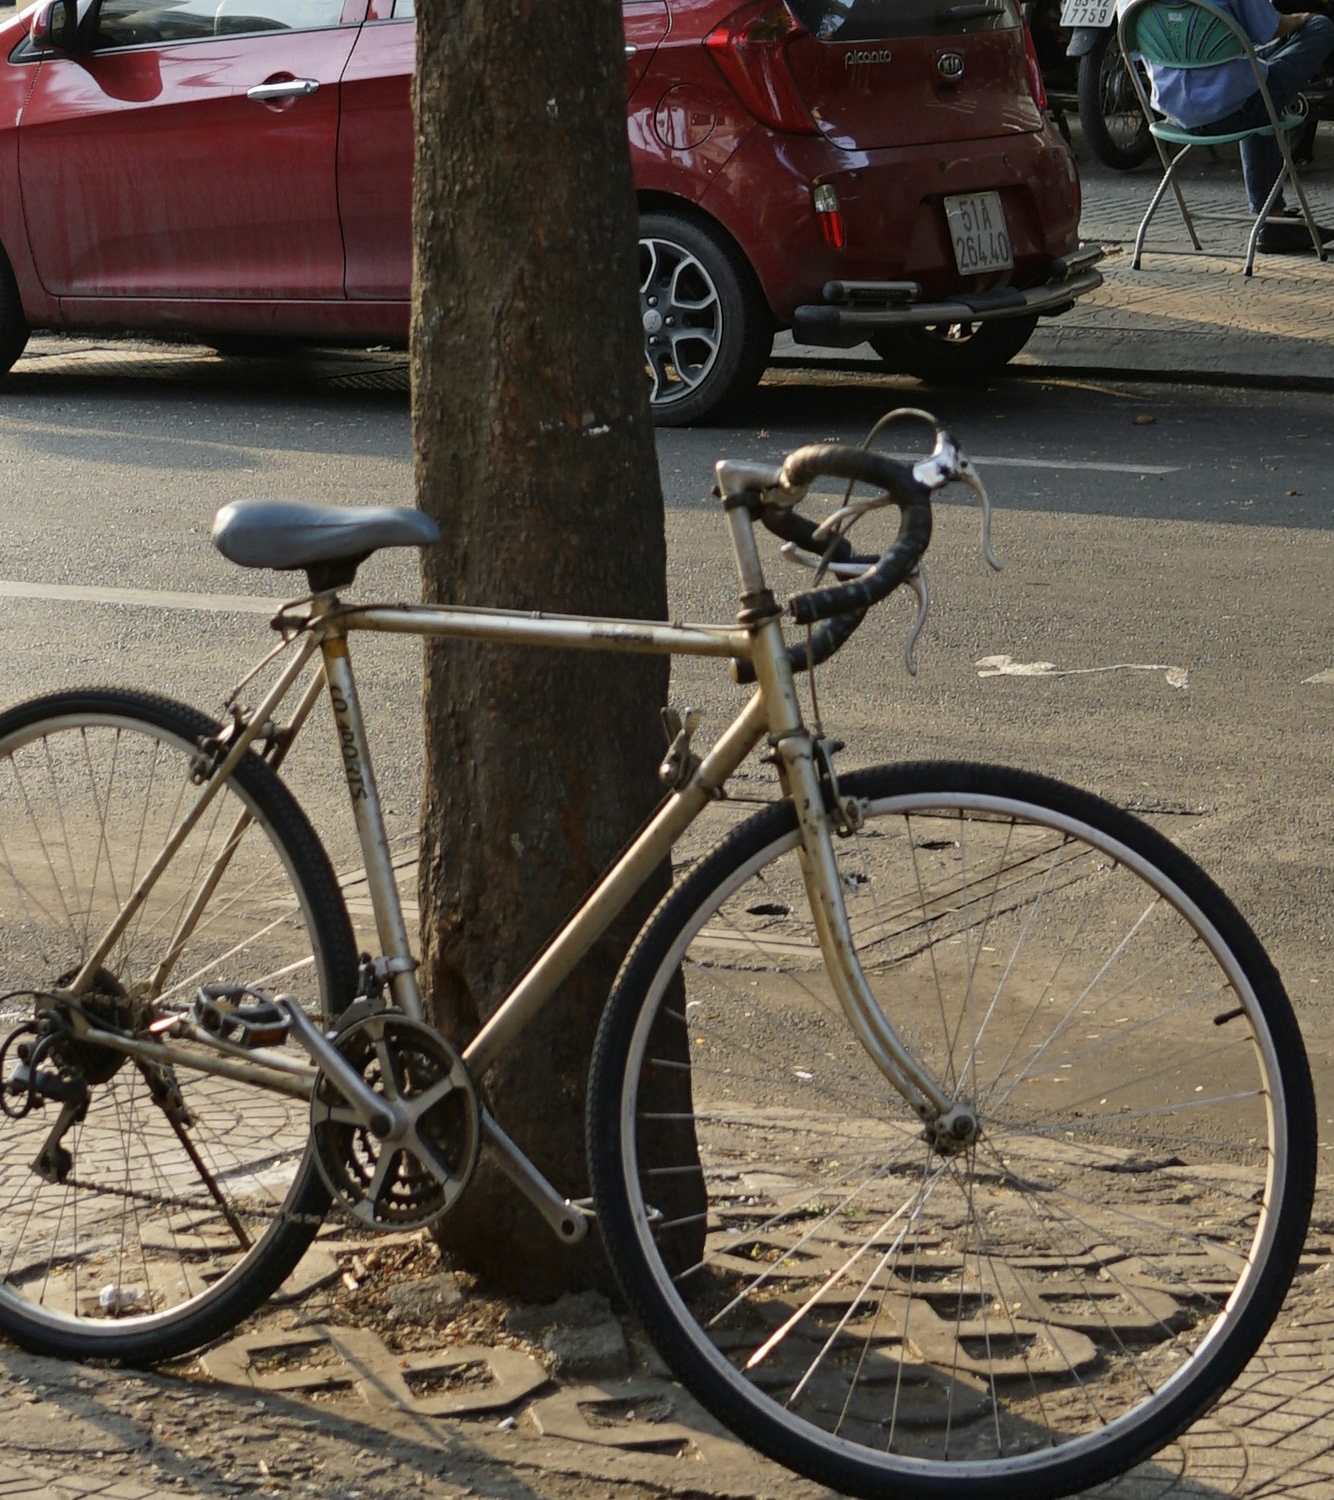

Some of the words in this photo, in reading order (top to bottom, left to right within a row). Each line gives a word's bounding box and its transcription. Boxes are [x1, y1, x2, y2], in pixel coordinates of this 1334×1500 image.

[1070, 9, 1107, 23] 7759
[844, 49, 892, 69] picanto
[959, 198, 993, 233] 51A
